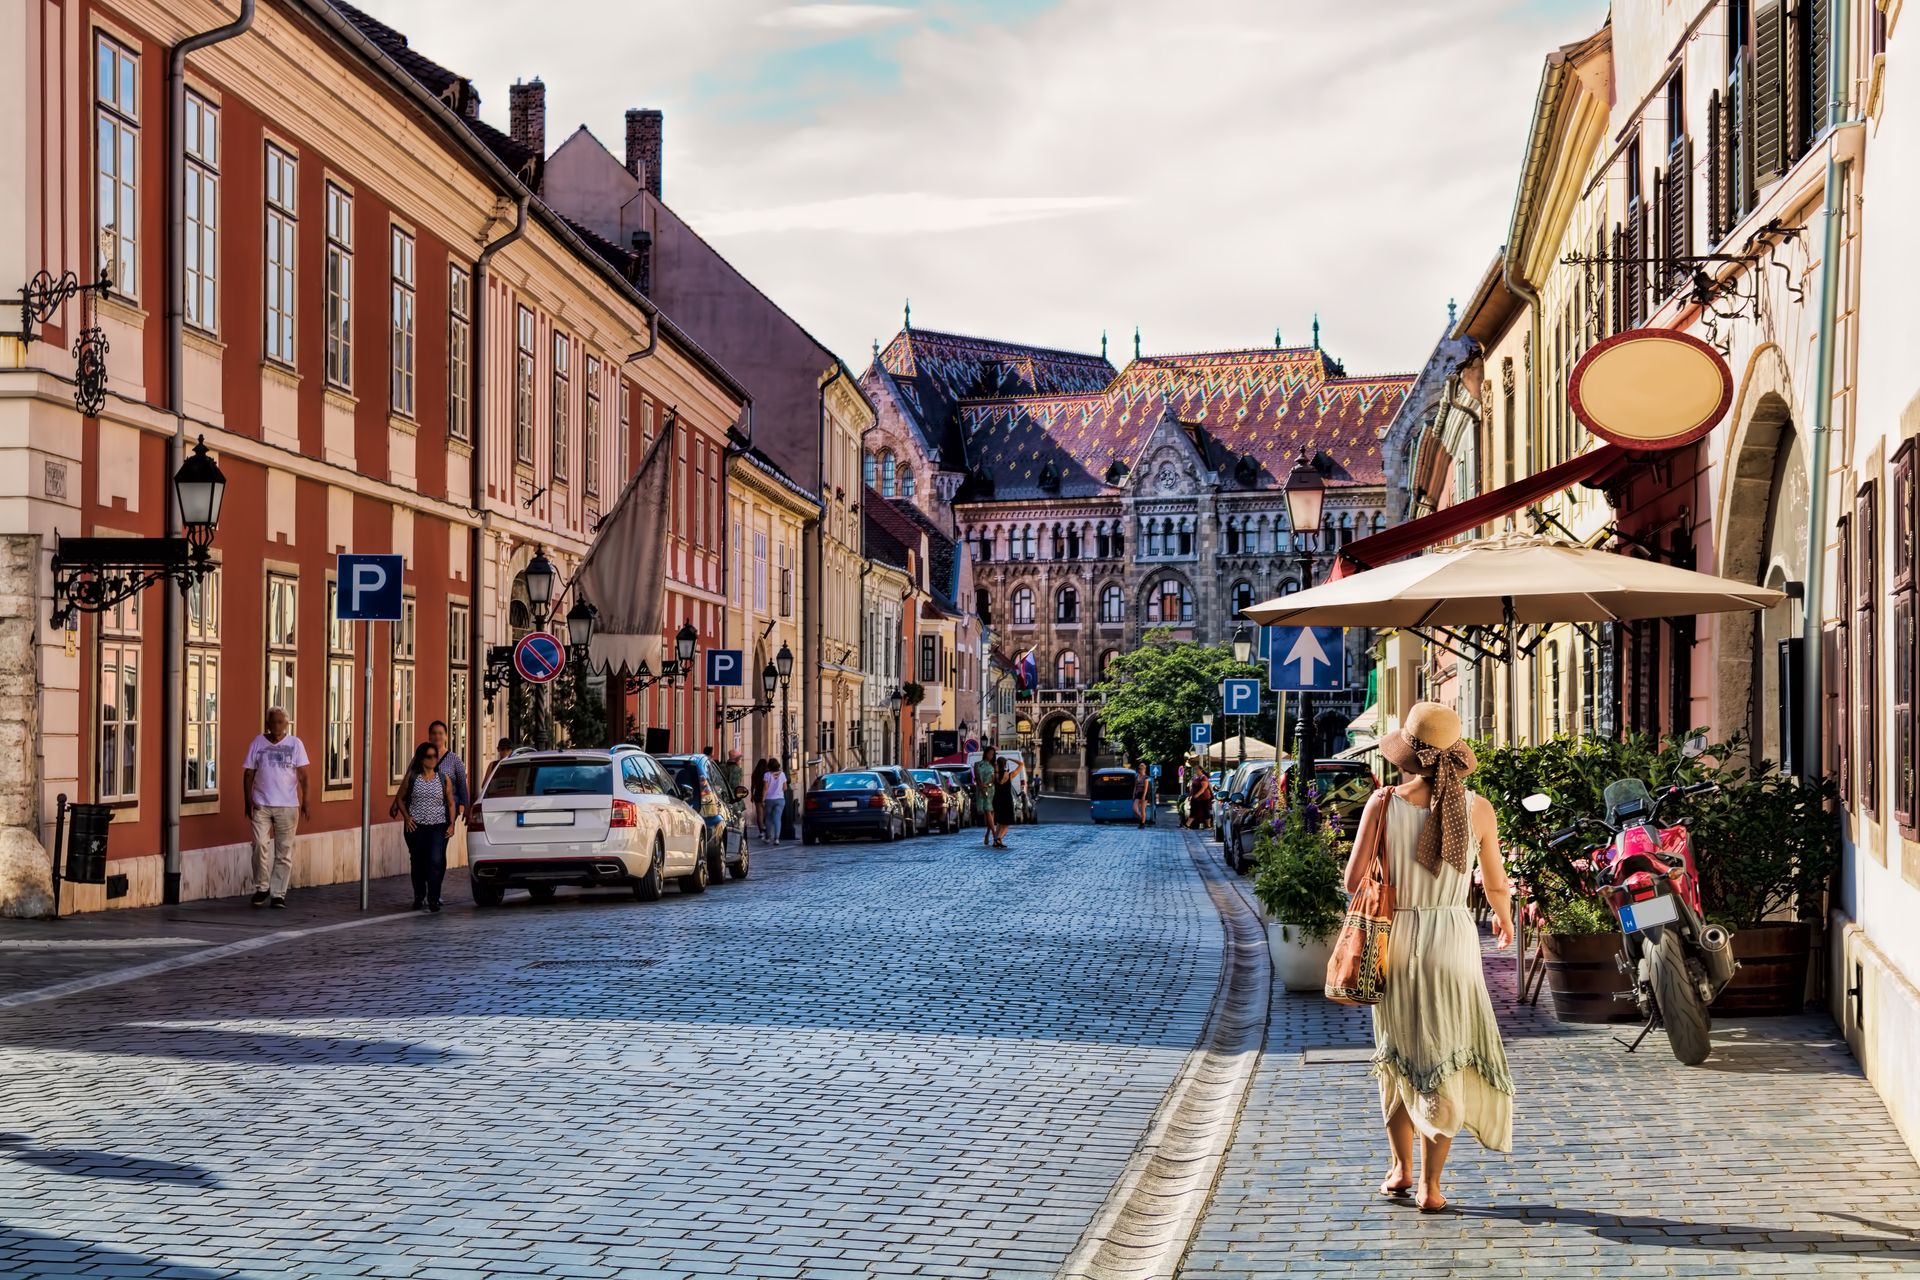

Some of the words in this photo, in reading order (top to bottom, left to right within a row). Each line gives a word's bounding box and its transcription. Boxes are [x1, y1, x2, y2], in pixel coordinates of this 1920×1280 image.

[352, 564, 386, 611] P
[715, 655, 734, 681] P
[1233, 685, 1251, 709] P
[1196, 727, 1206, 741] P
